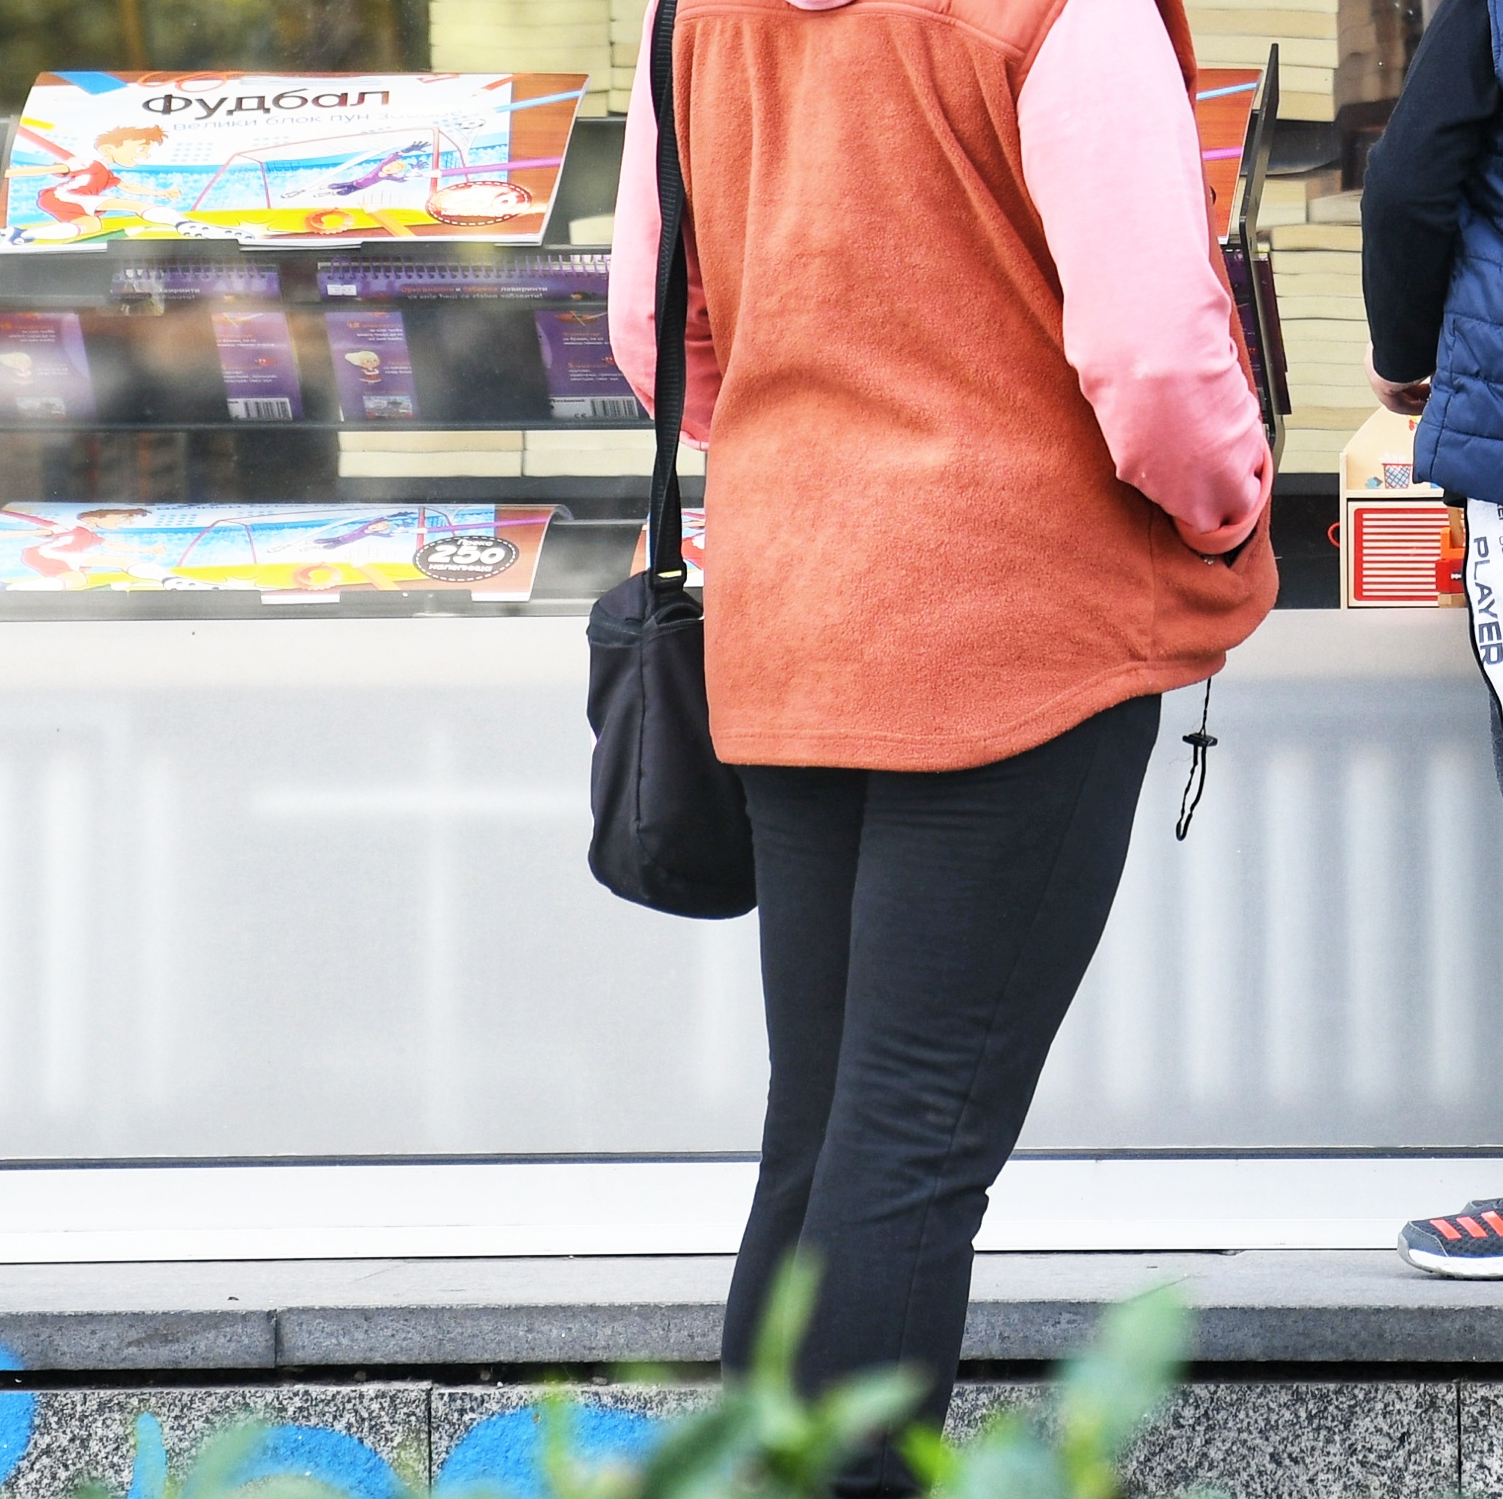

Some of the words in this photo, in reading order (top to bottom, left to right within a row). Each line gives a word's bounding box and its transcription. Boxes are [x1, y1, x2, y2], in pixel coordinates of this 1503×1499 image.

[141, 88, 390, 120] Фудбал
[173, 119, 257, 132] велики
[265, 113, 323, 127] блок
[329, 111, 370, 126] пун
[427, 545, 506, 566] 250
